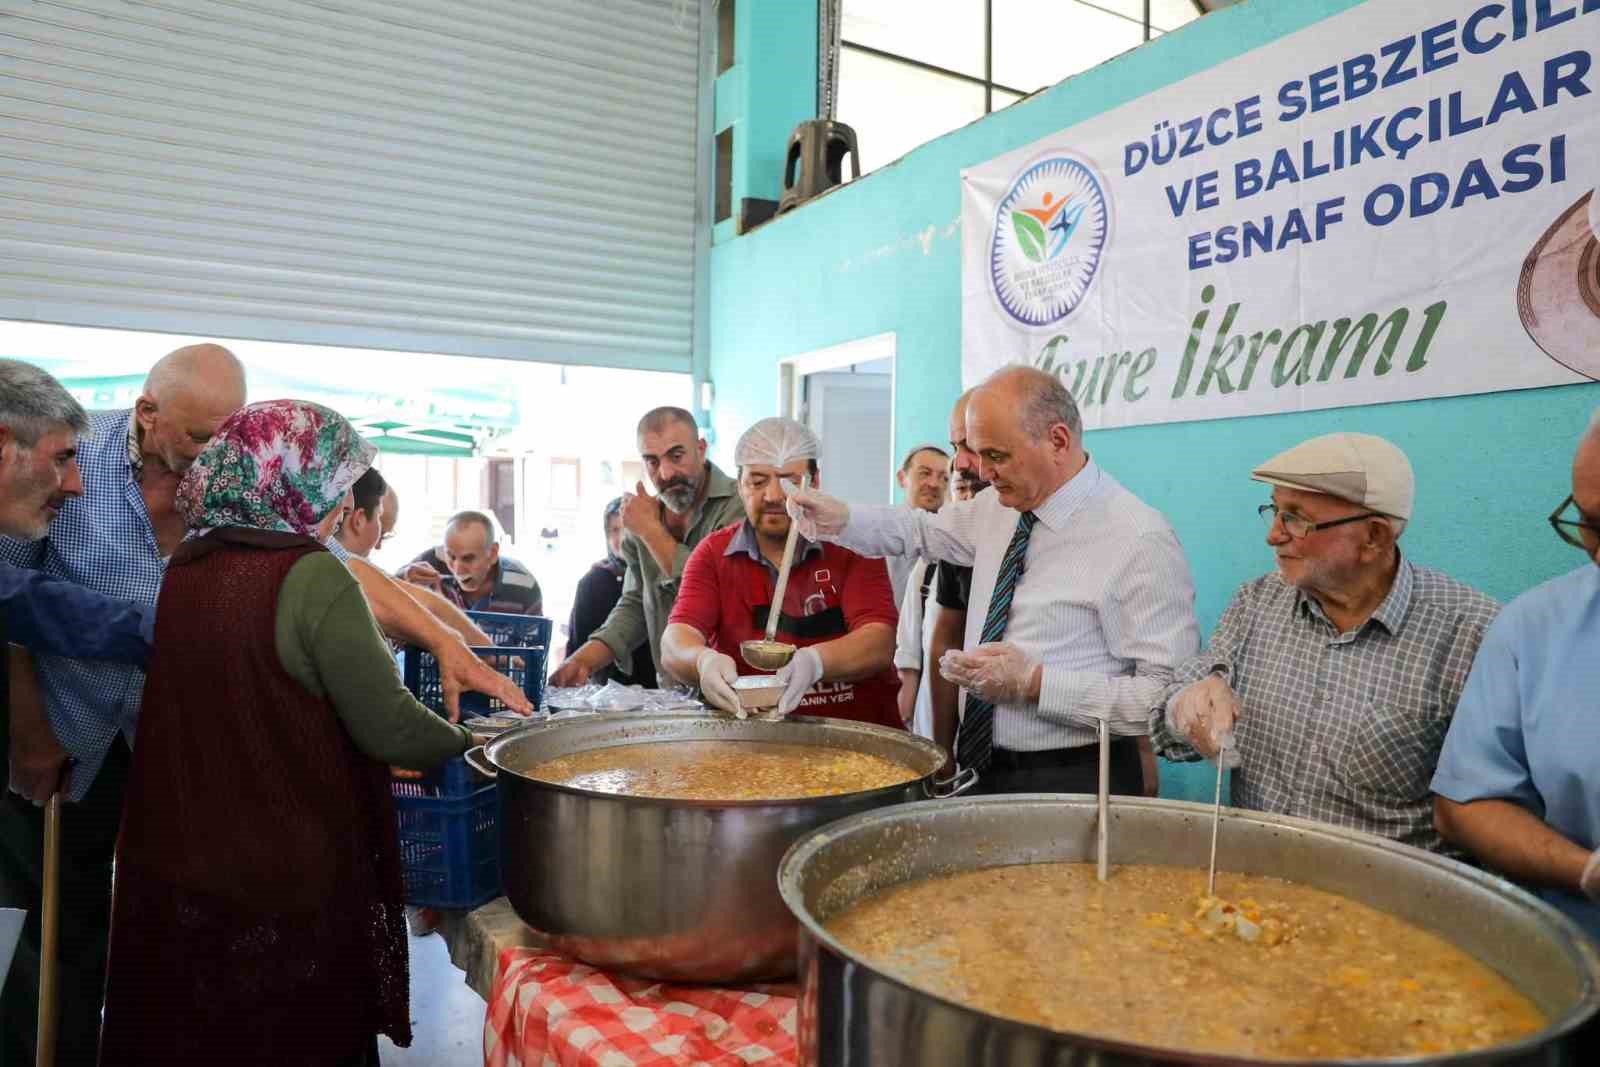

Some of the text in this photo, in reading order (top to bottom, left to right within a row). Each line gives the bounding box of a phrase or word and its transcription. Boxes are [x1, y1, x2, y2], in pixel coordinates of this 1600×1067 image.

[1124, 0, 1600, 176] DÜZCE SEBZECL
[1165, 50, 1592, 217] VE BALIKÇILAR
[1188, 134, 1566, 271] ESNAF ODASI
[1171, 284, 1448, 398] İkramı
